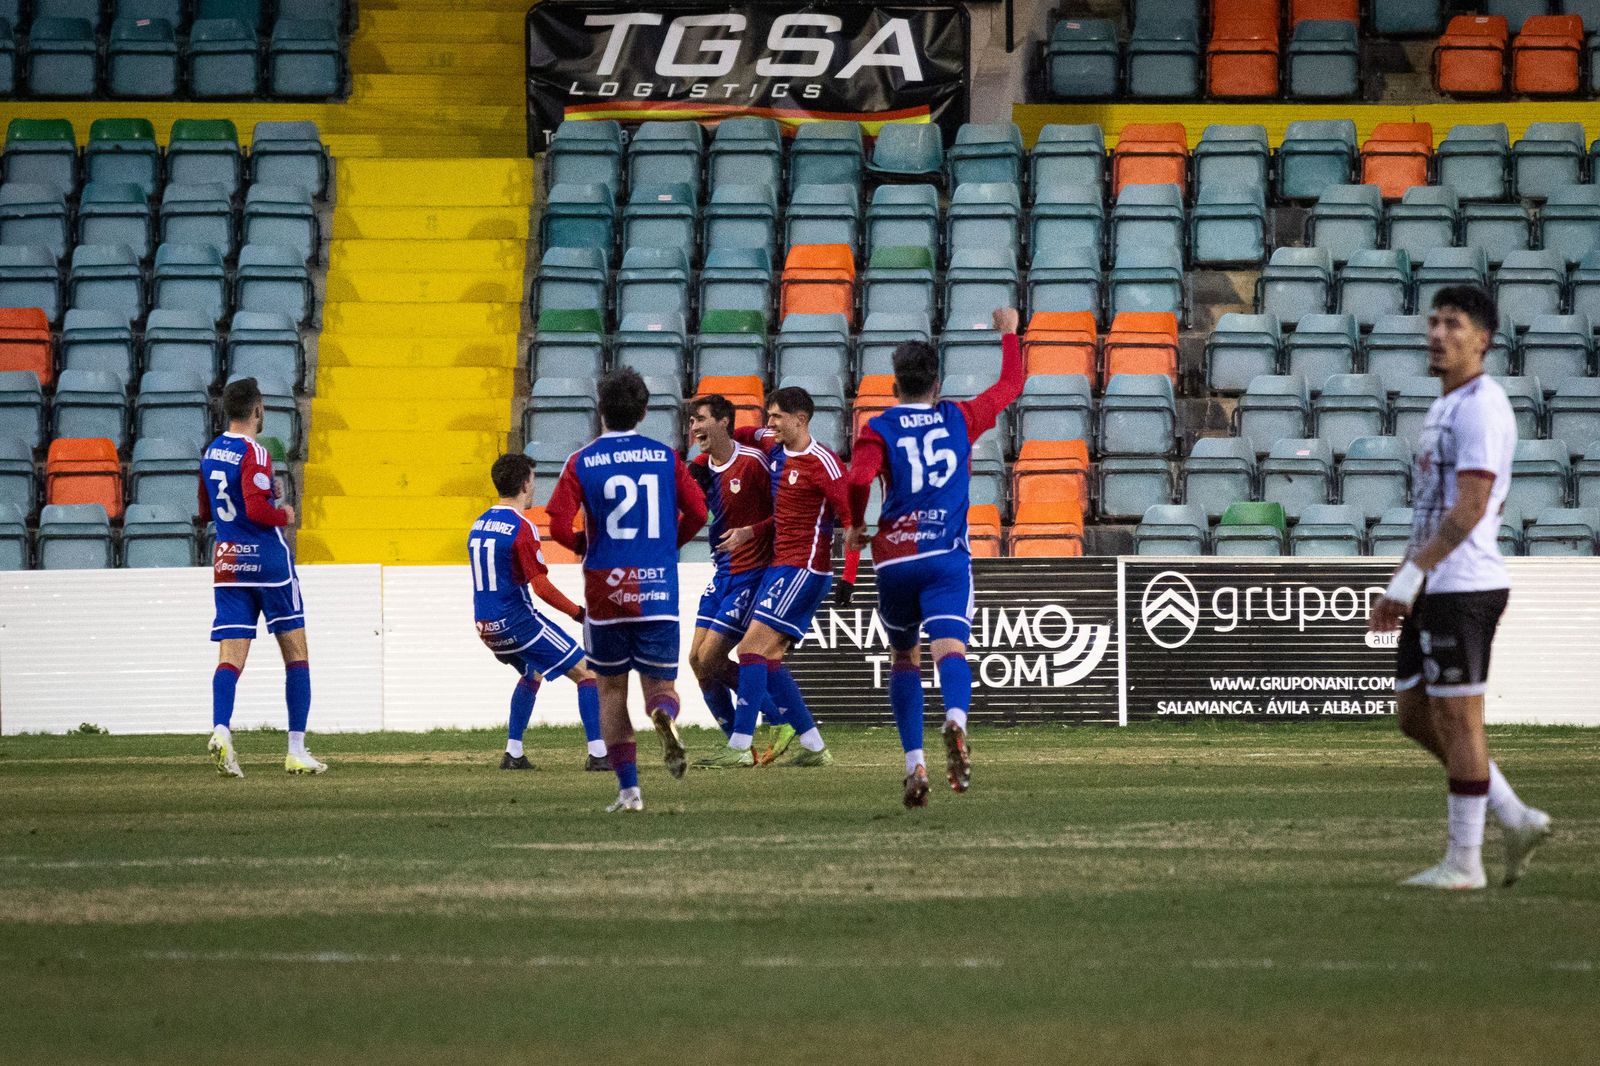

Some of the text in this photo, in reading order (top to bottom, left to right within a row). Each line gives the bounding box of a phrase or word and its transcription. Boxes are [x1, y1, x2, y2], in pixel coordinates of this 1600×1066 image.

[585, 12, 924, 82] TGSA
[569, 81, 822, 99] LOGISTICS
[899, 411, 944, 428] OJEDA
[584, 447, 667, 468] IVÁN GONZÁLEZ
[896, 427, 958, 494] 15
[209, 470, 237, 522] 3
[603, 473, 660, 540] 21
[908, 509, 947, 521] ADBT
[483, 518, 516, 536] ÁLVAREZ
[228, 544, 259, 554] ADBT
[470, 538, 498, 592] 11
[628, 568, 665, 580] ADBT
[484, 618, 507, 631] ADBT
[1210, 676, 1396, 690] WWW.GRUPONANI.COM
[1157, 701, 1255, 715] SALAMANCA
[1266, 697, 1310, 715] ÁVILA
[1322, 701, 1362, 715] ALBA
[1365, 701, 1385, 715] DE
